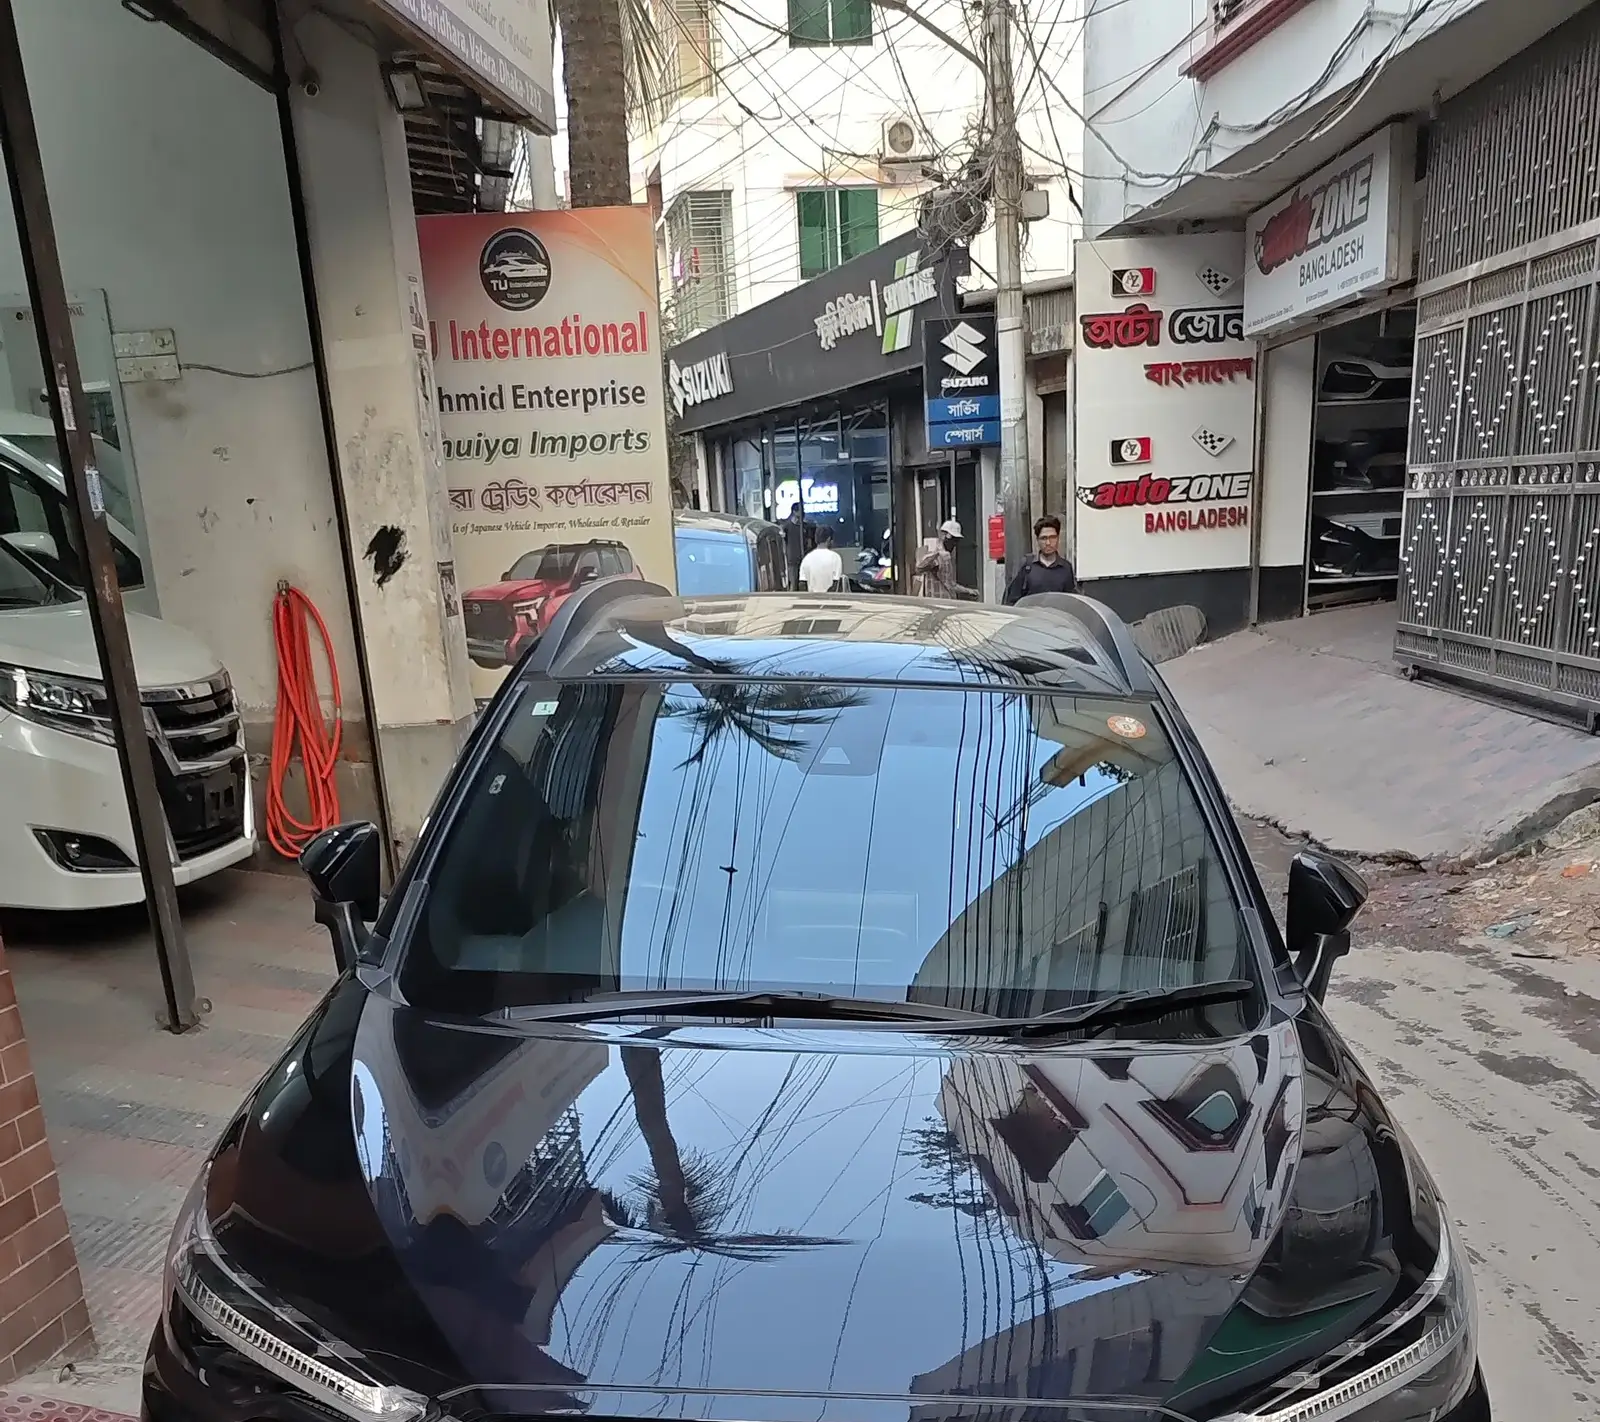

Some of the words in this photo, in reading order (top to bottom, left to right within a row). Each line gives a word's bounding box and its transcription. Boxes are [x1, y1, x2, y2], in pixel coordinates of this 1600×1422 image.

[468, 32, 499, 82] Vatara,
[1299, 235, 1365, 287] BANGLADESH
[490, 279, 508, 291] TU
[448, 311, 648, 361] International
[1081, 304, 1163, 348] অটো
[682, 352, 734, 406] SUZUKI
[941, 376, 989, 388] SUZUKI
[1144, 358, 1254, 389] বাংলাদেশ
[511, 380, 646, 413] Enterprise
[947, 400, 980, 417] সার্ভিস
[529, 428, 649, 459] Imports
[945, 424, 984, 443] স্পেয়ার্স
[481, 478, 541, 511] ট্রেডিং
[544, 478, 650, 505] কর্পোরেশন
[1092, 473, 1253, 508] autoZONE
[460, 522, 470, 535] of
[470, 523, 502, 535] Japanese
[504, 521, 531, 531] Vehicle
[569, 516, 608, 528] Wholesaler
[621, 516, 650, 528] Retailer
[1145, 506, 1248, 534] BANGLADESH
